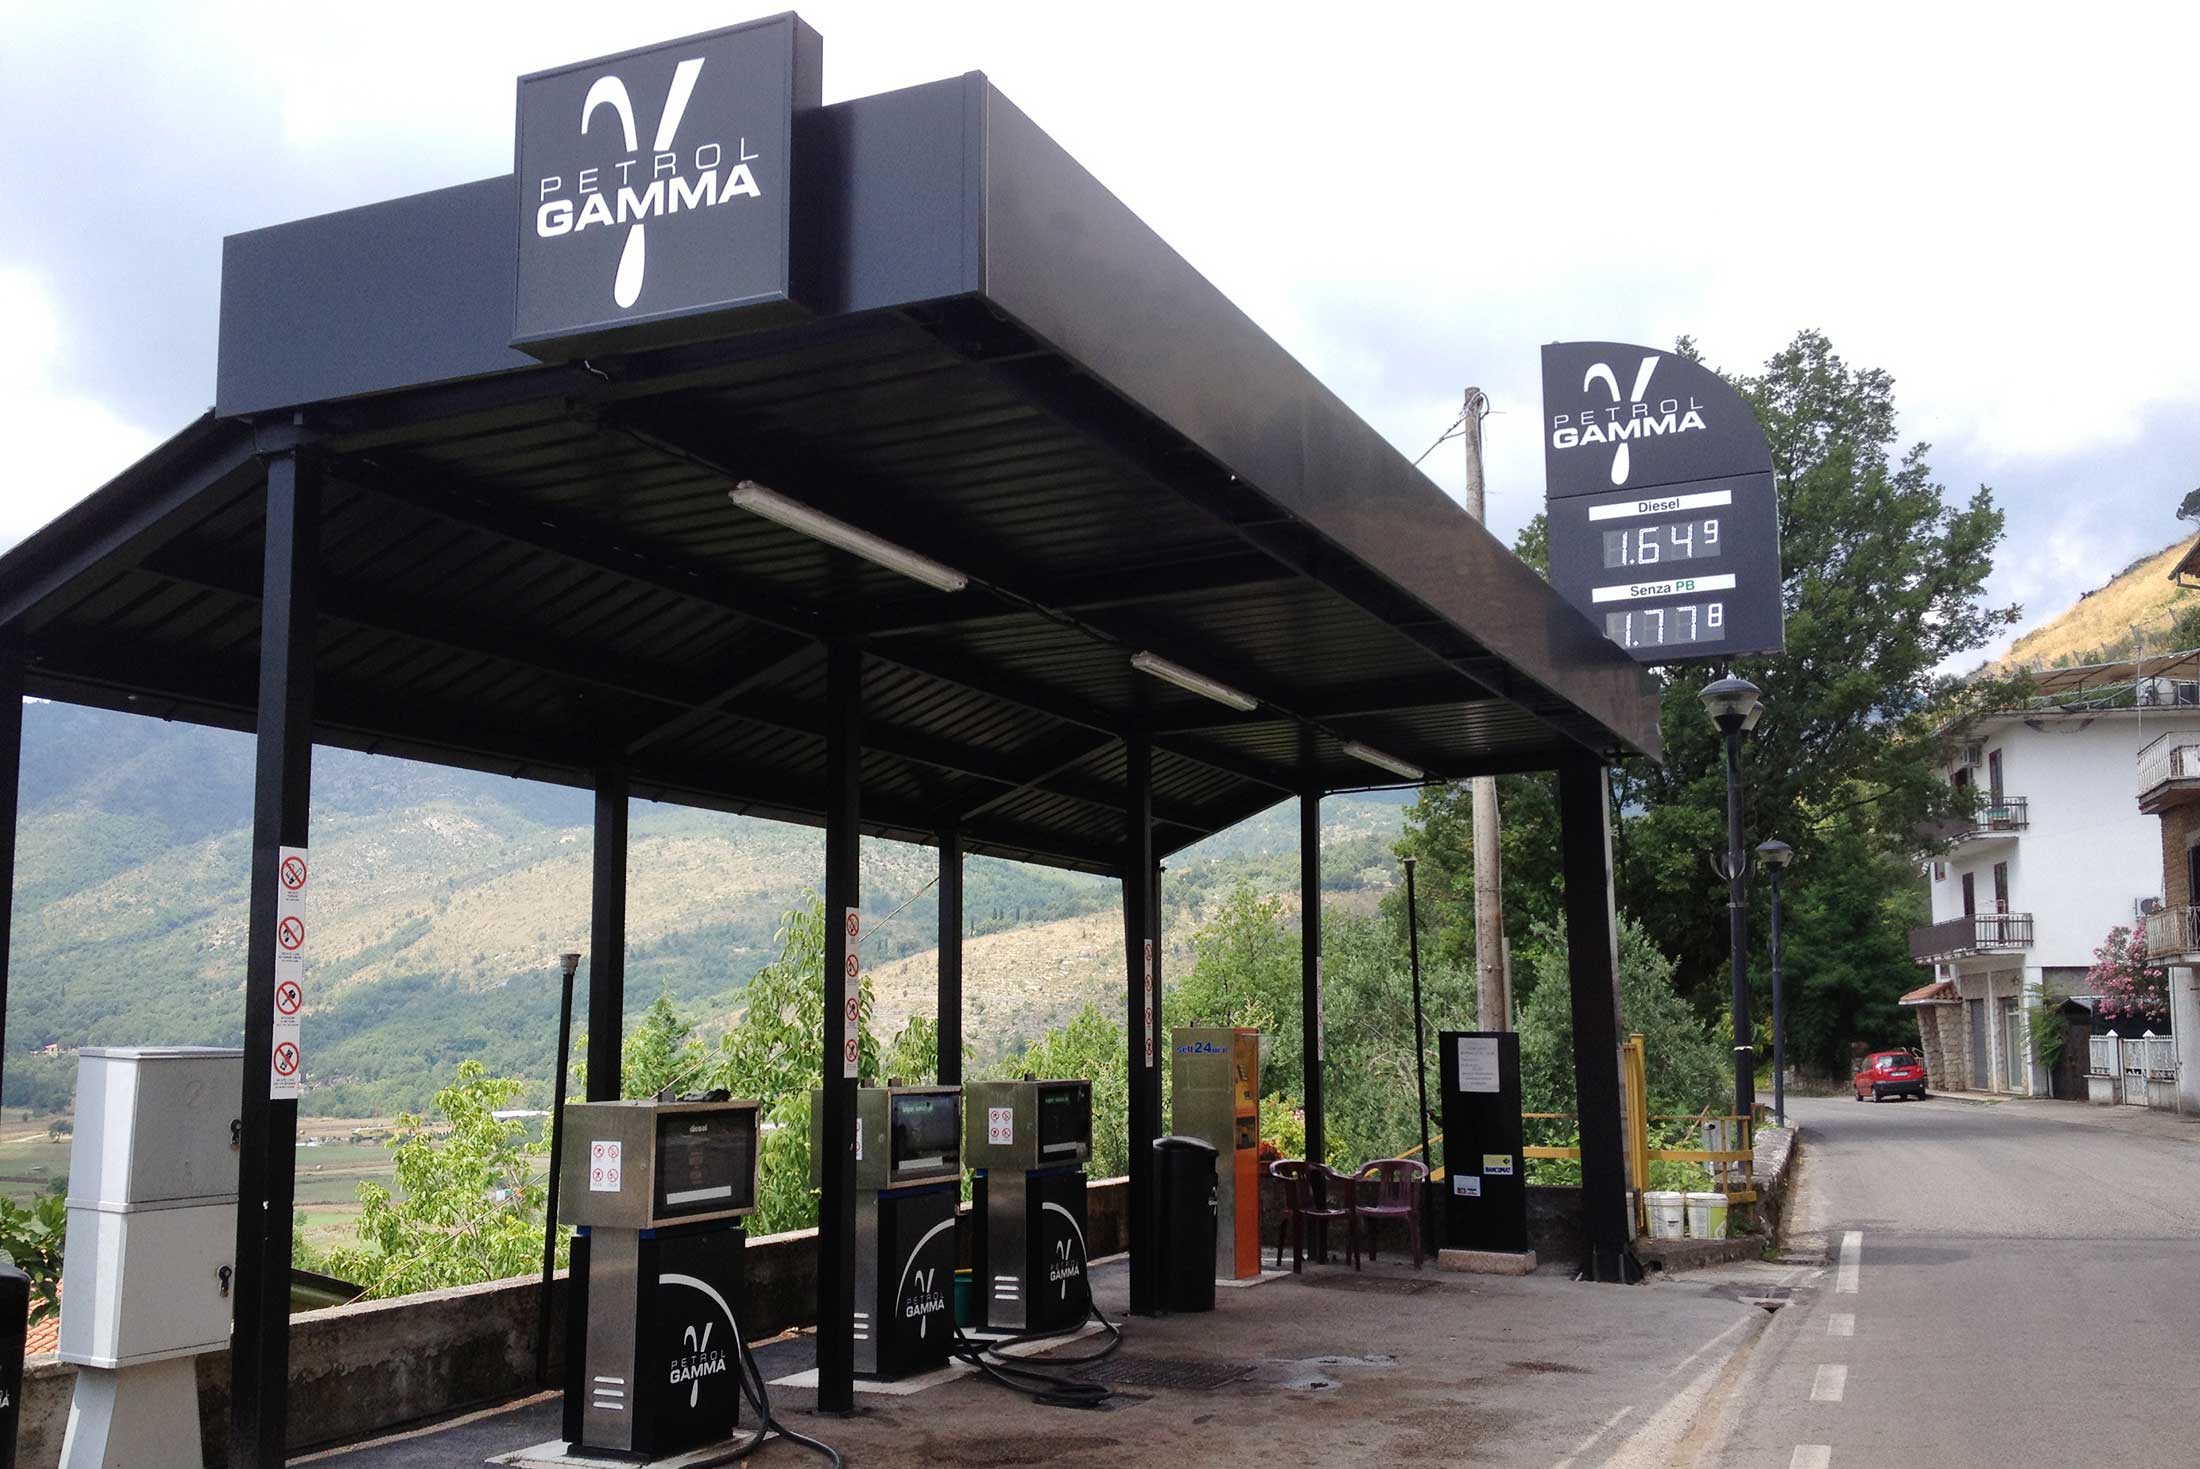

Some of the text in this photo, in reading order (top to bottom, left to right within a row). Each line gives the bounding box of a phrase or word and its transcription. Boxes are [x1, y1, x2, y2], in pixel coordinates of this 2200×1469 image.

[540, 137, 759, 202] PETROL
[537, 163, 761, 238] GAMMA
[1554, 396, 1704, 428] PETROL
[1552, 411, 1706, 449] GAMMA
[1638, 498, 1680, 513] Diesel
[1630, 580, 1696, 597] Senza PB
[906, 1298, 945, 1318] GAMMA
[670, 1358, 726, 1384] GAMMA
[671, 1348, 726, 1370] PETROL
